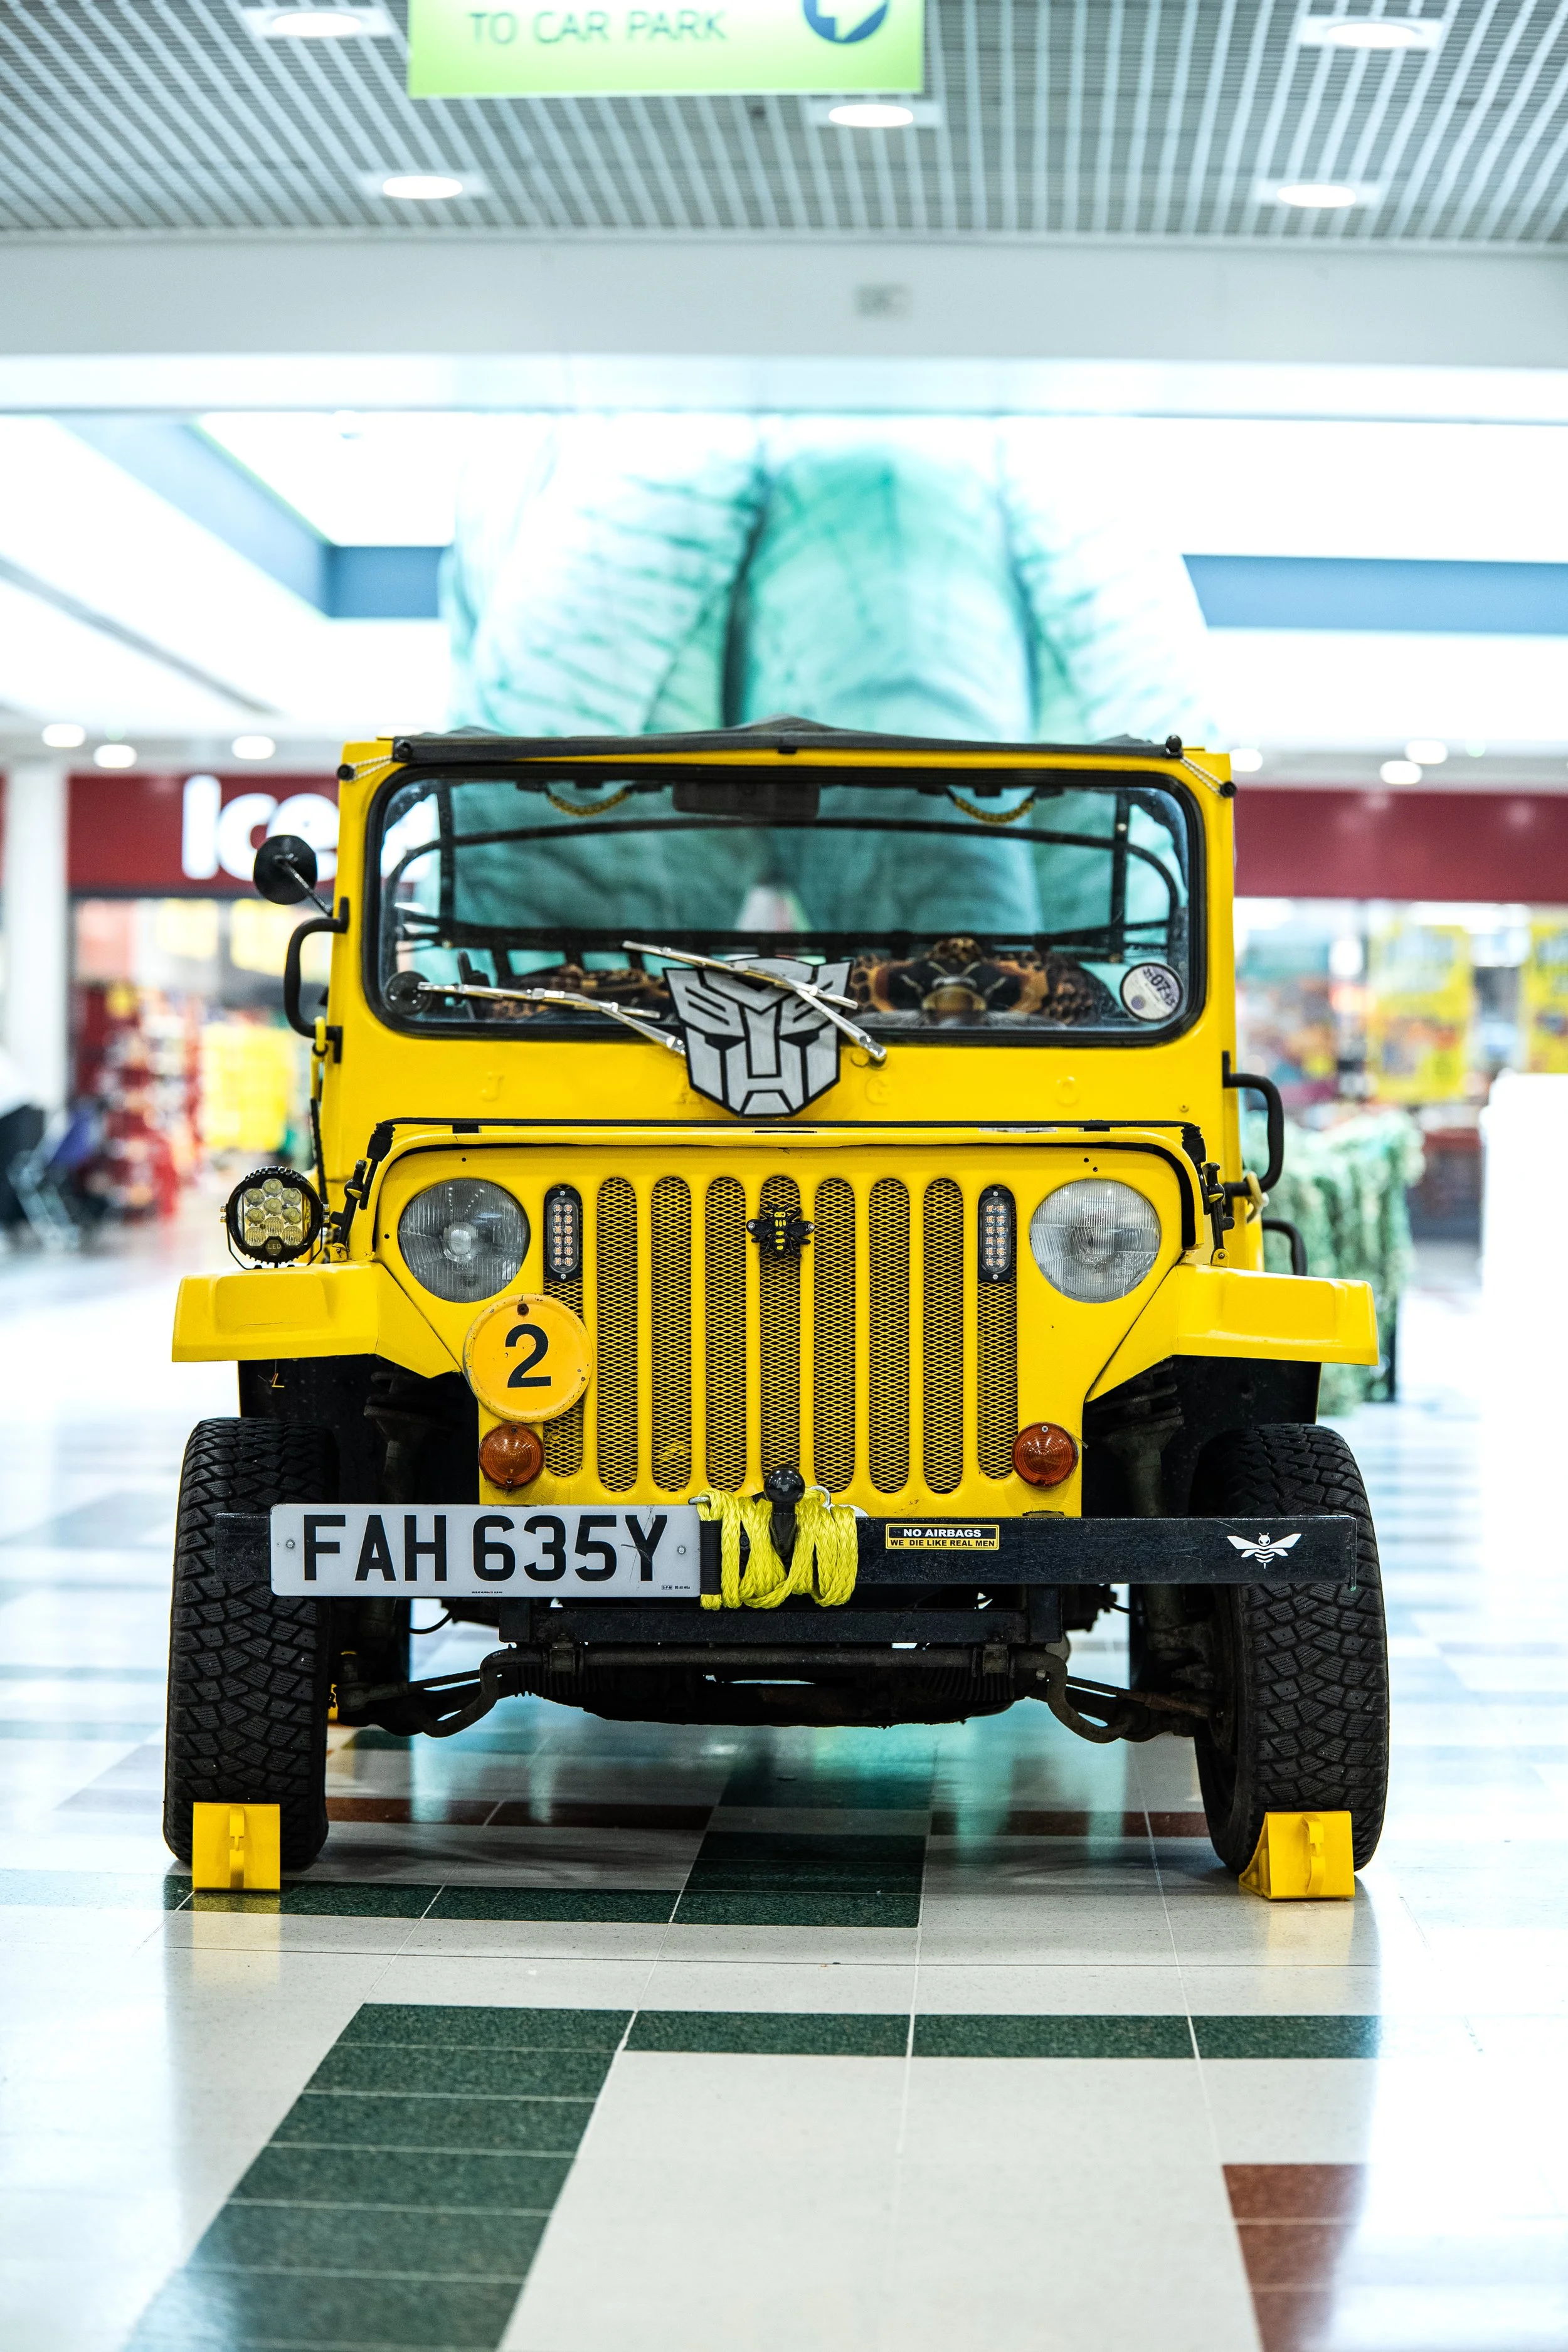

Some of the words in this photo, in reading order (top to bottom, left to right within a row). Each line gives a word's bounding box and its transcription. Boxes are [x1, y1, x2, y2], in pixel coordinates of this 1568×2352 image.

[467, 11, 519, 44] TO
[533, 11, 610, 44] CAR
[626, 9, 728, 43] PARK
[505, 1323, 552, 1389] 2
[303, 1514, 447, 1582] FAH
[472, 1514, 668, 1582] 635Y
[903, 1528, 922, 1537] NO
[924, 1528, 982, 1538] AIRBAGS
